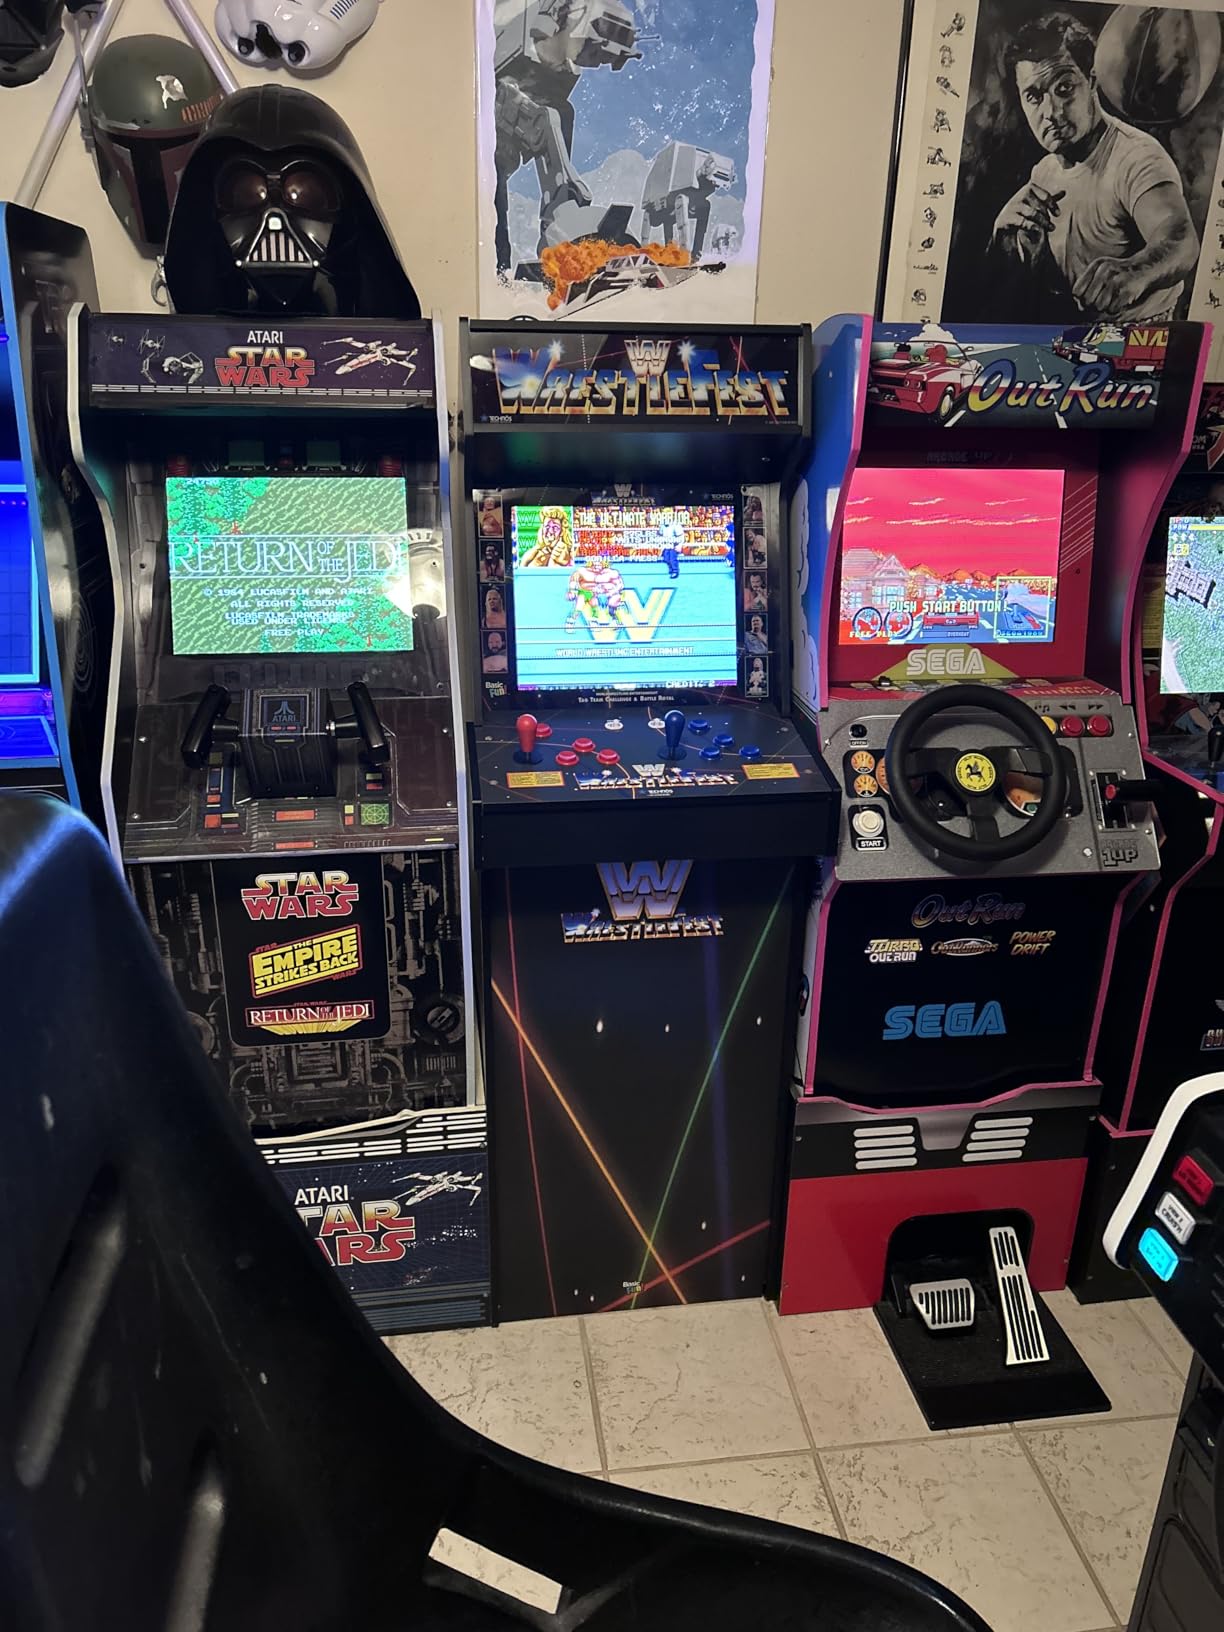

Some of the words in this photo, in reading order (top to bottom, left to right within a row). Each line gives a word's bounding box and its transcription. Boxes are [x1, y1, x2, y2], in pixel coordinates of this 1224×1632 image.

[247, 330, 284, 344] ATARI
[215, 346, 315, 367] STAR
[215, 366, 315, 387] WARS
[318, 541, 336, 555] OF
[168, 541, 314, 574] RETURN
[318, 558, 345, 573] THE
[250, 588, 310, 597] LUCASFILM
[314, 588, 335, 596] AND
[230, 600, 252, 608] ALL
[256, 600, 297, 608] RIGHTS
[889, 600, 917, 612] PUSH
[922, 601, 956, 613] START
[225, 612, 285, 620] LUCASFILM
[264, 629, 292, 637] FREE
[297, 628, 325, 636] PLAY
[906, 647, 987, 676] SEGA
[485, 681, 503, 689] Basic
[860, 840, 882, 848] START
[241, 870, 359, 897] STAR
[241, 893, 360, 920] WARS
[1009, 930, 1057, 944] POWER
[292, 939, 313, 950] THE
[1010, 943, 1051, 956] DRIFT
[252, 933, 358, 978] EMPIRE
[254, 962, 319, 990] STRIKES
[319, 951, 358, 973] BACK
[250, 1007, 320, 1025] RETURN
[331, 1003, 371, 1026] JEDI
[883, 1000, 1007, 1041] SEGA
[294, 1184, 349, 1205] ATARI
